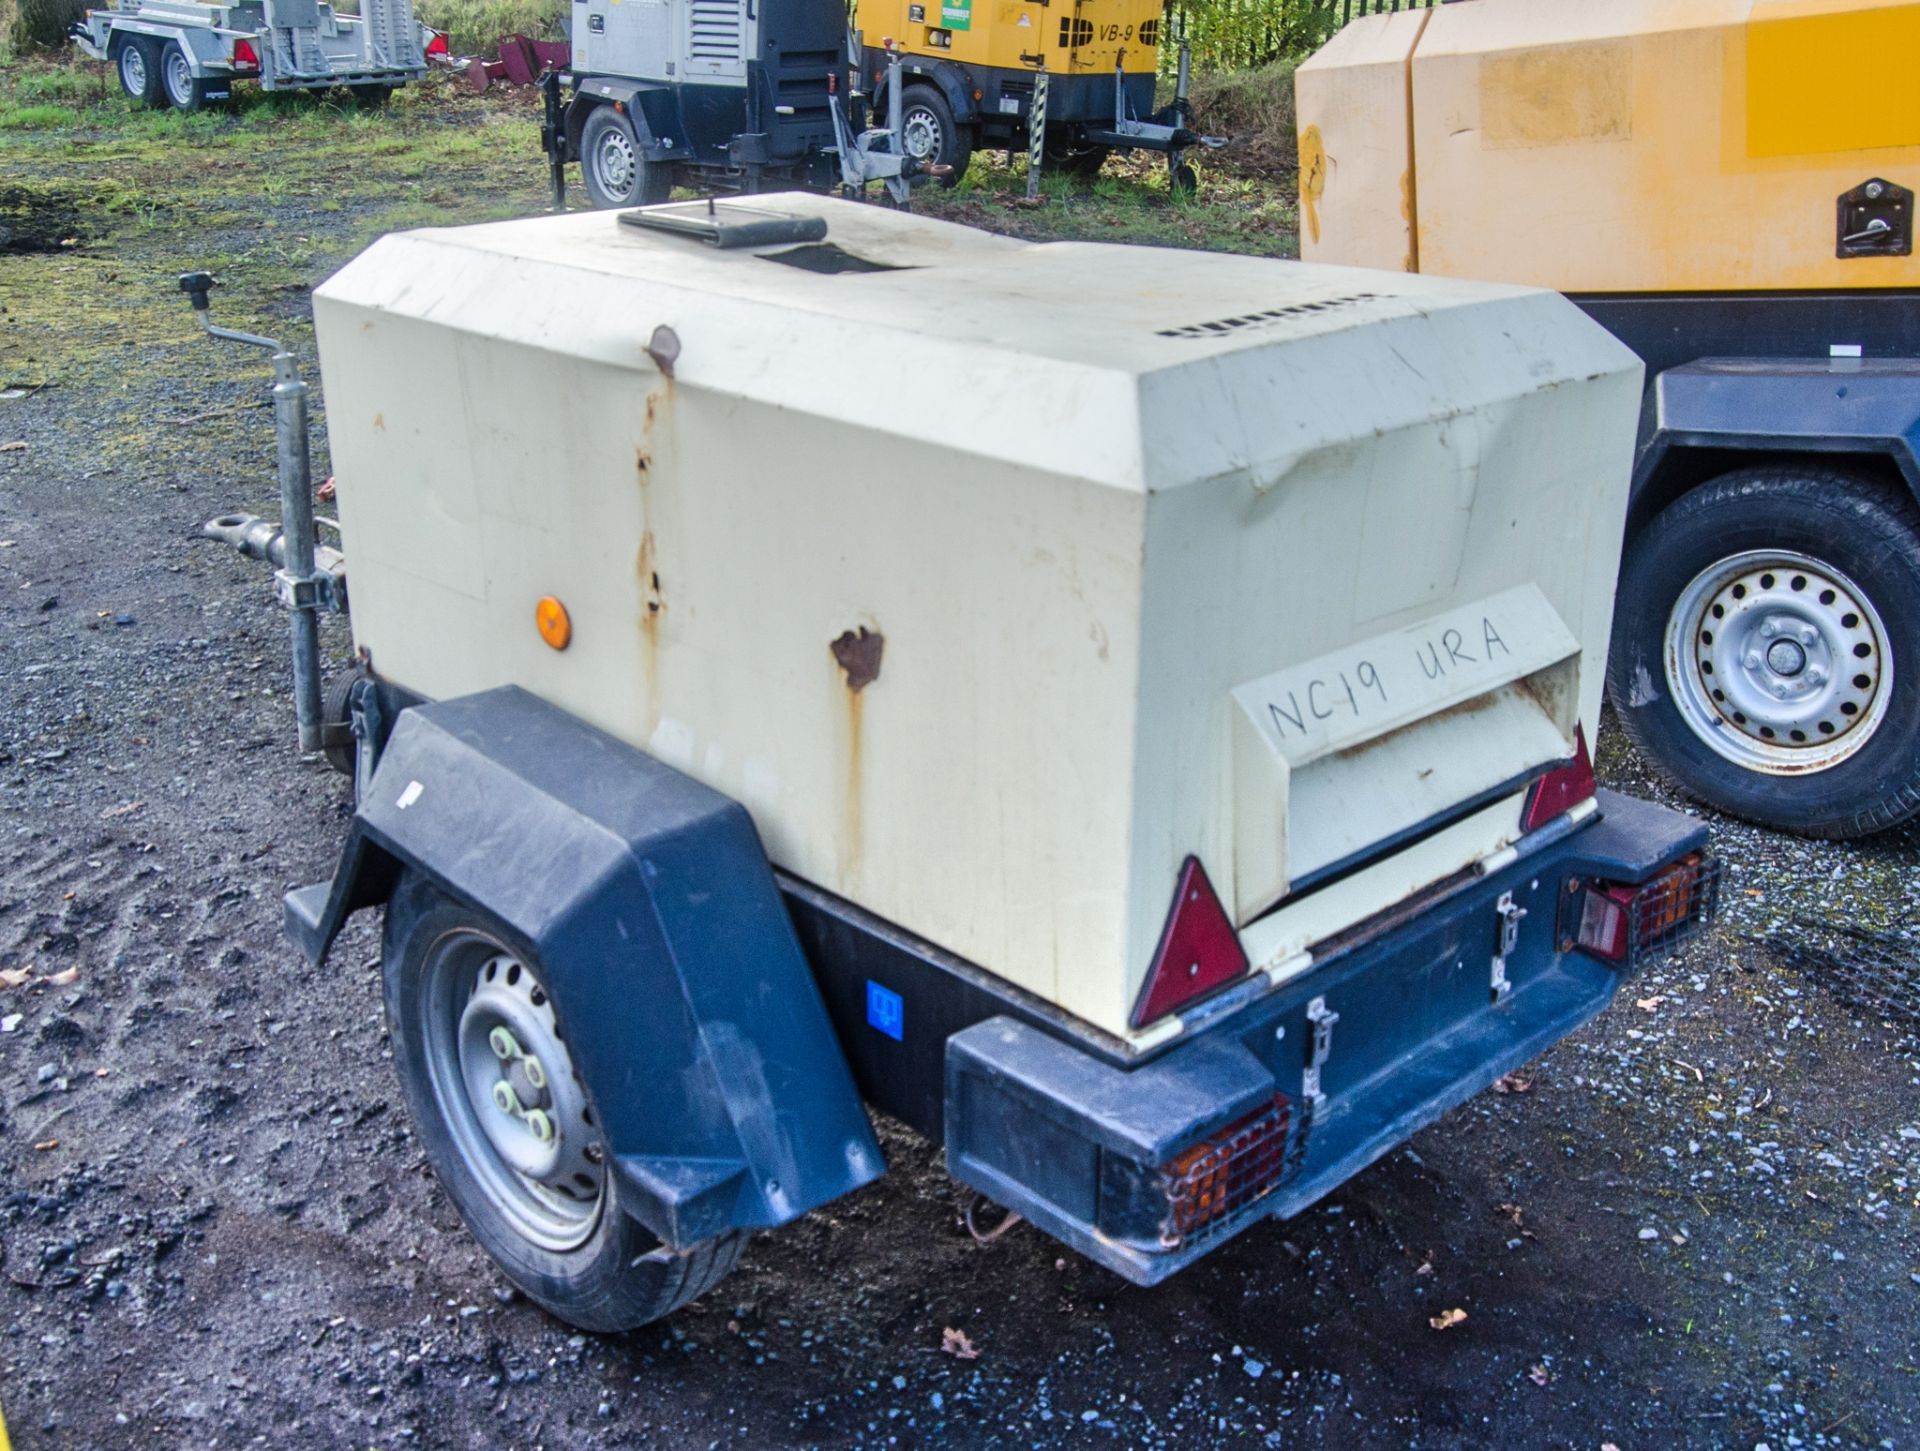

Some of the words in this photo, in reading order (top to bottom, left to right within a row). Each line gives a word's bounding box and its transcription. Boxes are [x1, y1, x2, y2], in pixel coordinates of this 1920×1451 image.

[1100, 24, 1133, 42] VB-9
[1268, 661, 1387, 739] NC19
[1416, 617, 1510, 680] URA
